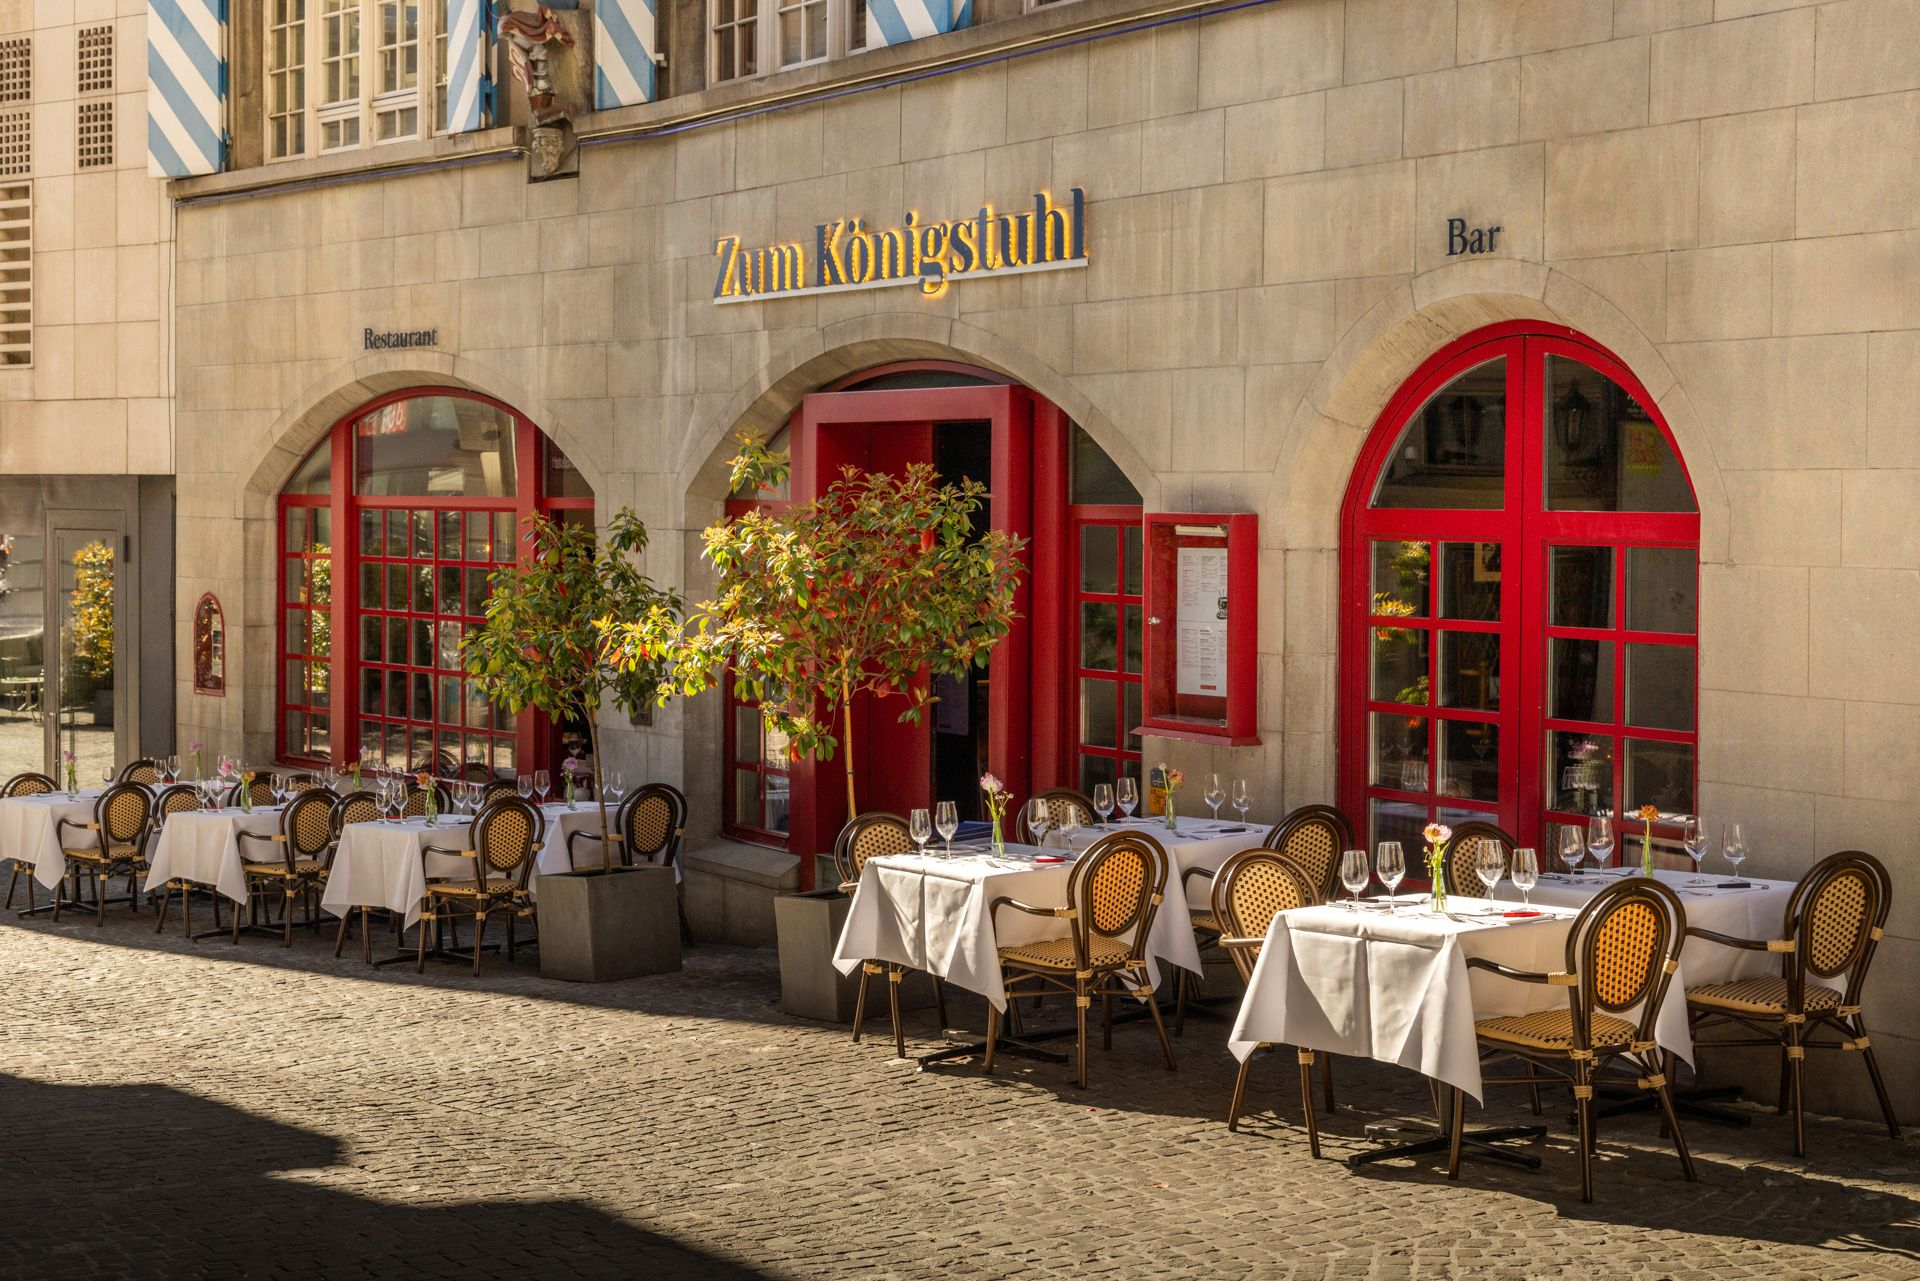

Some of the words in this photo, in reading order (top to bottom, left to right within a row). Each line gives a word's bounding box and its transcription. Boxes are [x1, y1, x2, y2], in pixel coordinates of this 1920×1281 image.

[713, 236, 800, 299] Zum
[814, 187, 1085, 295] Königstuhl
[1446, 217, 1501, 257] Bar
[363, 327, 438, 350] Restaurant
